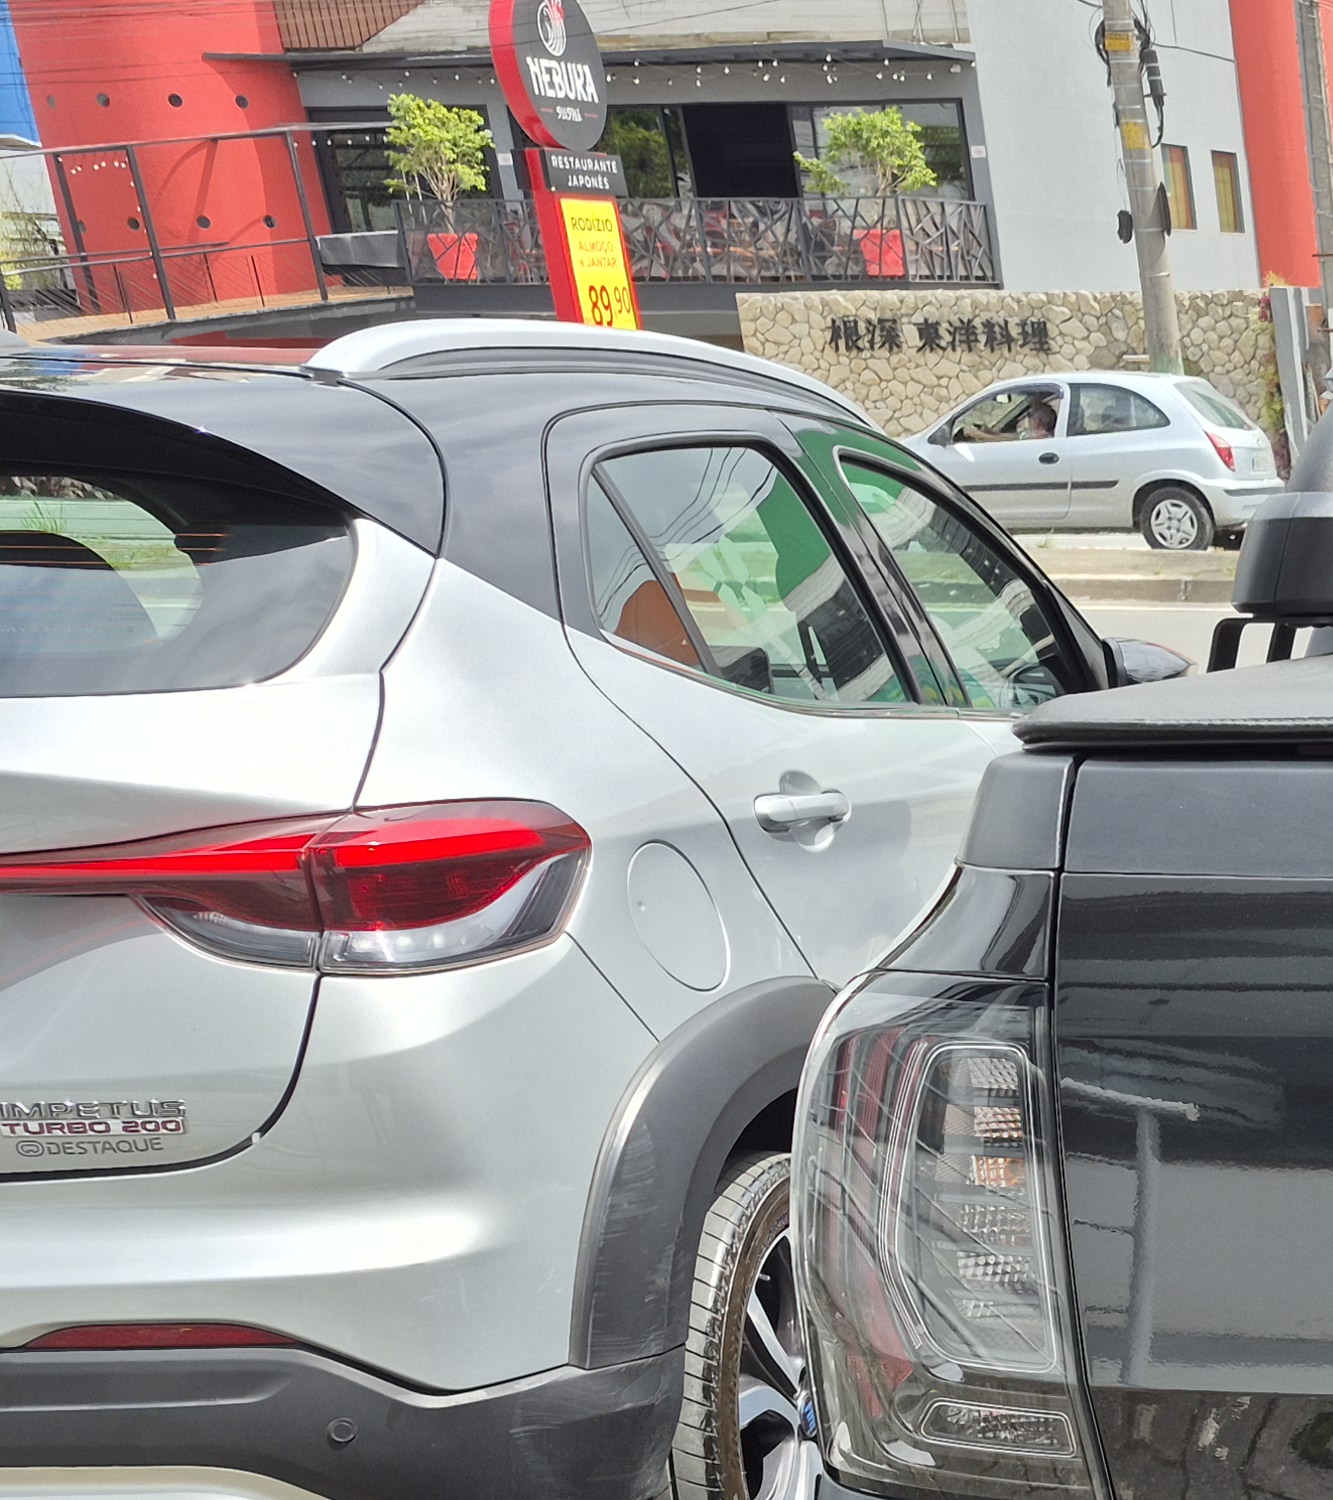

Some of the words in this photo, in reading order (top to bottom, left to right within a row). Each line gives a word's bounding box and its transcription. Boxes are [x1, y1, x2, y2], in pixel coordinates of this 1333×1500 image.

[526, 56, 599, 103] NEBUKA
[551, 155, 618, 173] RESTAURANTE
[568, 174, 610, 190] JAPONÊS
[571, 214, 613, 232] RODÍZIO
[579, 241, 614, 255] ALMOÇO
[587, 257, 619, 268] JANTAR
[0, 1099, 186, 1119] IMPETUS
[1, 1122, 112, 1135] TURBO
[121, 1120, 182, 1133] 200
